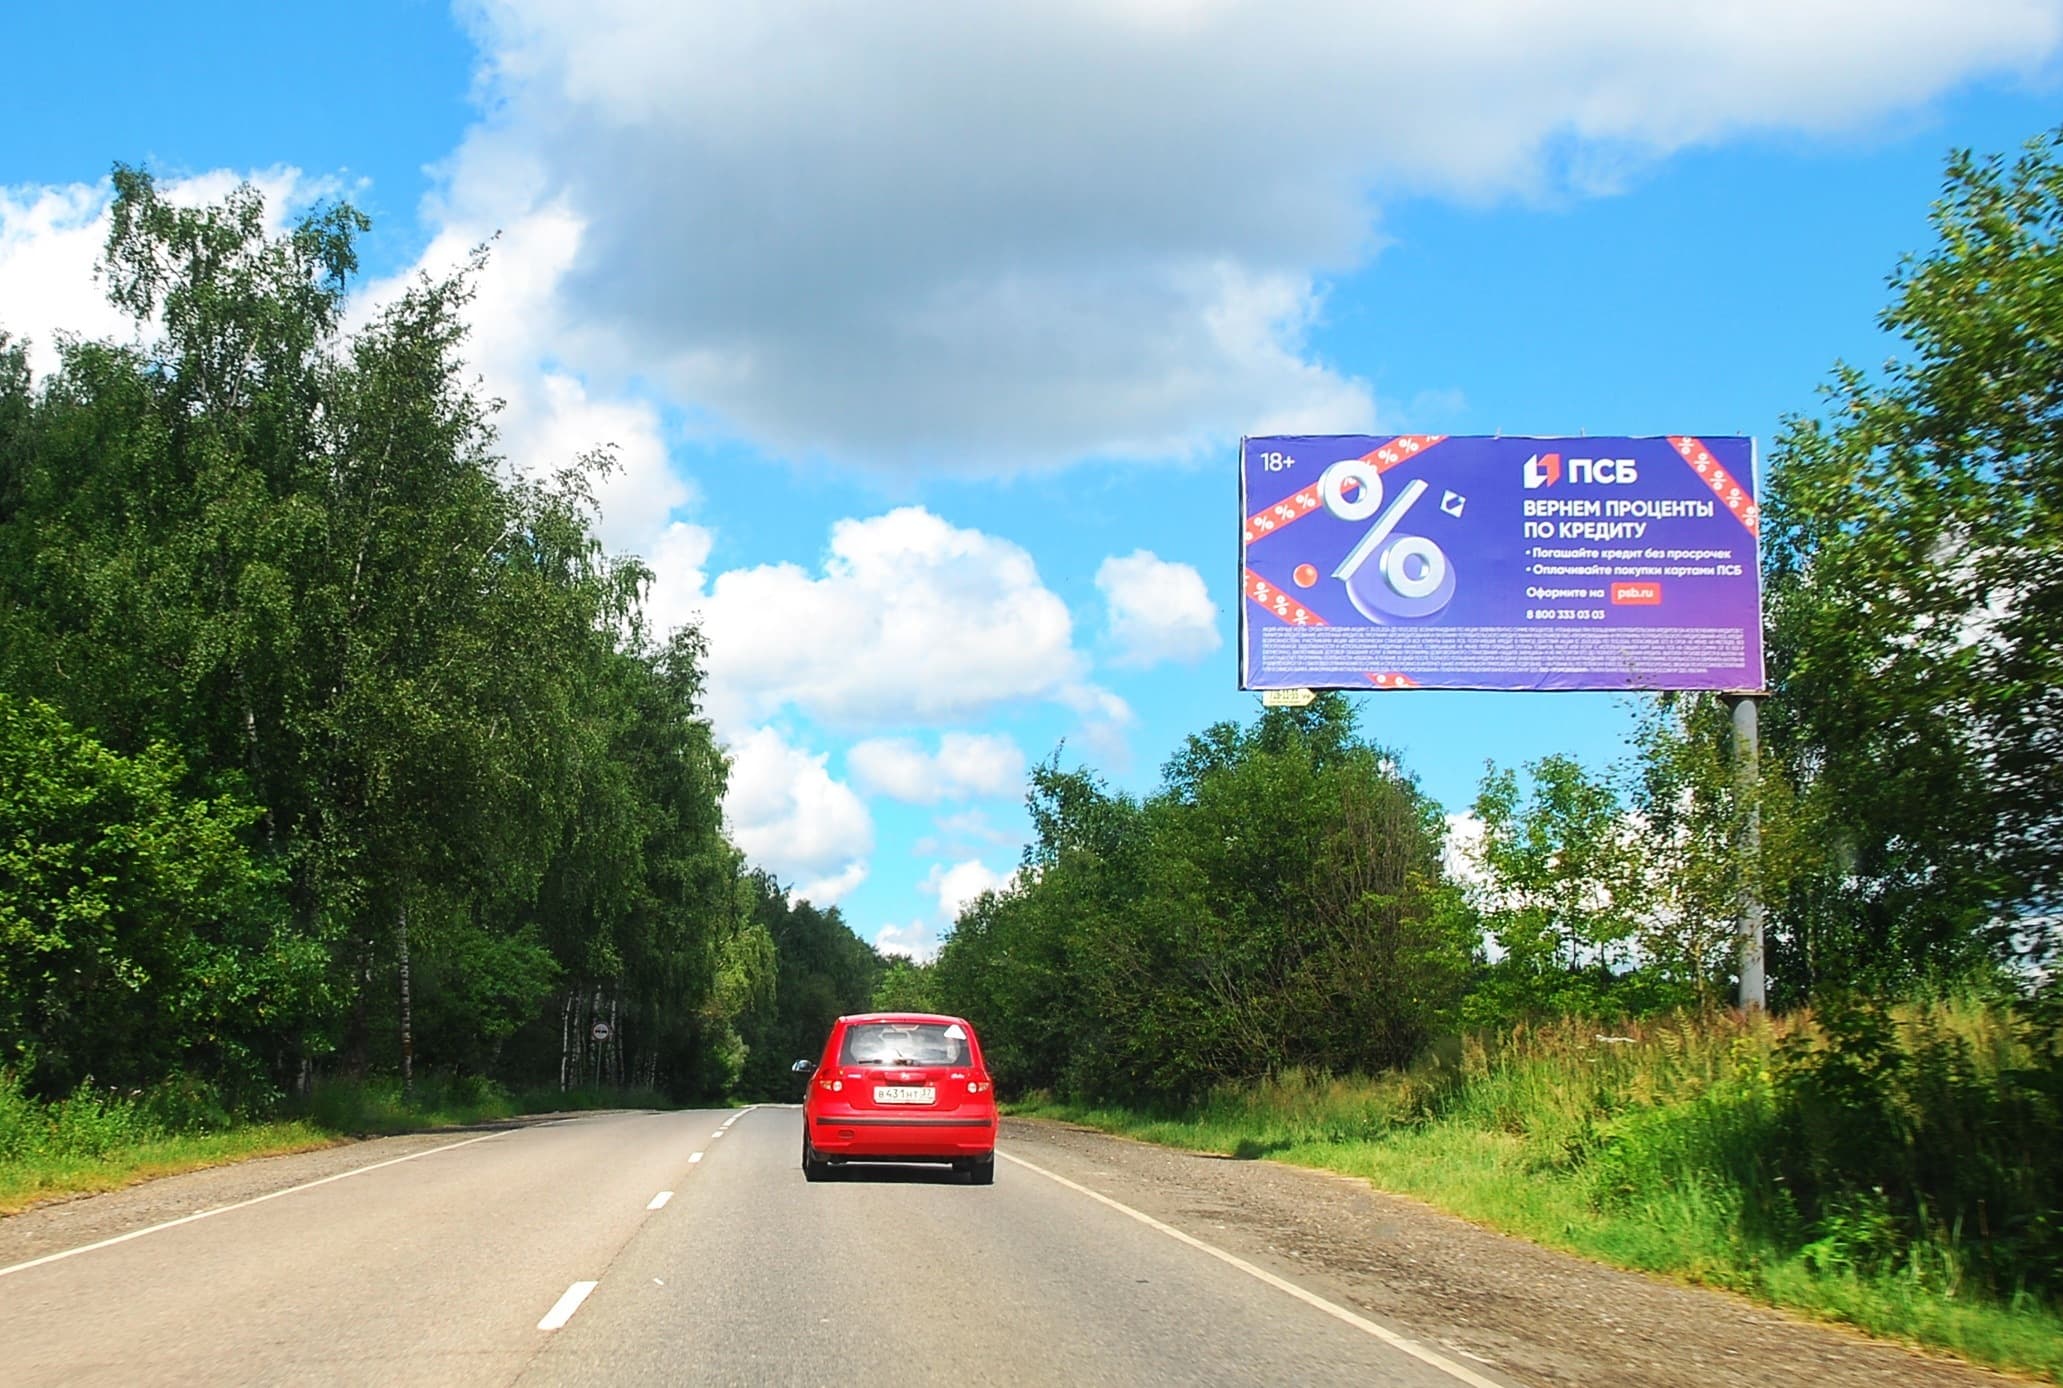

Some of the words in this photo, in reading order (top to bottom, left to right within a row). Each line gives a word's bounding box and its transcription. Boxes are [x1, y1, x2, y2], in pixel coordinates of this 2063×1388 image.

[1260, 453, 1295, 471] 18+
[1568, 458, 1638, 484] ПСБ
[1523, 500, 1600, 517] ВЕРНЕМ
[1605, 500, 1714, 519] ПРОЦЕНТЫ
[1524, 522, 1554, 538] ПО
[1559, 522, 1647, 541] КРЕДИТУ
[1532, 547, 1599, 559] Погашайте
[1601, 549, 1643, 560] кредит
[1645, 548, 1665, 559] без
[1667, 549, 1731, 560] просрочек
[1533, 564, 1612, 576] Оплачивайте
[1614, 566, 1662, 577] покупки
[1664, 566, 1714, 577] картами
[1717, 565, 1743, 576] ПСБ
[1526, 587, 1587, 600] Оформите
[1589, 589, 1605, 598] на
[1617, 587, 1654, 599] psb.ru
[1526, 609, 1534, 619] 8
[1535, 609, 1555, 619] 800
[1557, 609, 1576, 619] 333
[1577, 609, 1590, 619] 03
[1592, 609, 1605, 619] 03
